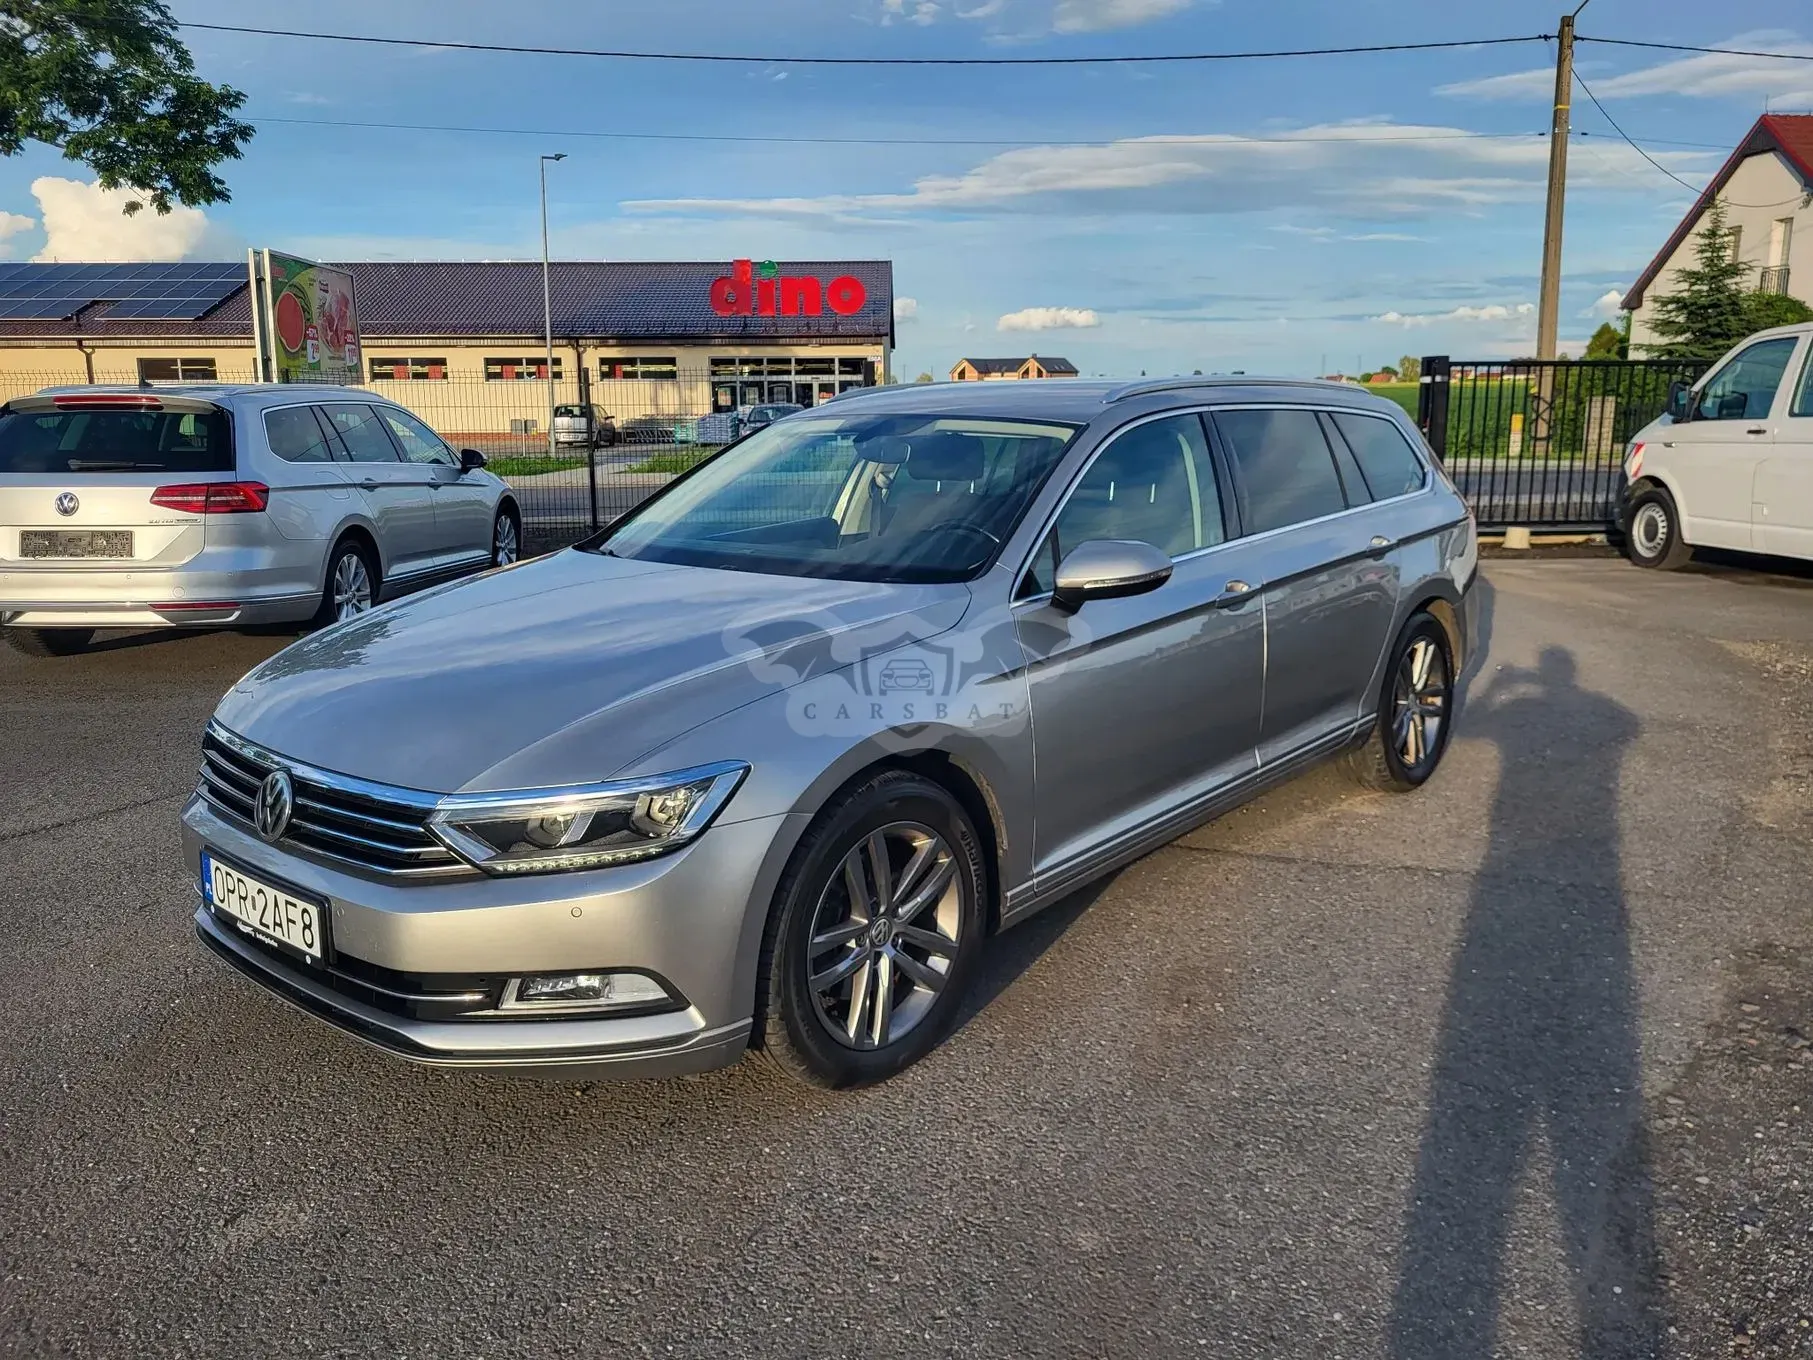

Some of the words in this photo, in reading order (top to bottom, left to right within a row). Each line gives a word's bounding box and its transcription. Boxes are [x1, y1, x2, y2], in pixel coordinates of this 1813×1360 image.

[710, 259, 867, 317] dino
[213, 865, 251, 921] OPR
[256, 887, 315, 949] 2AF8
